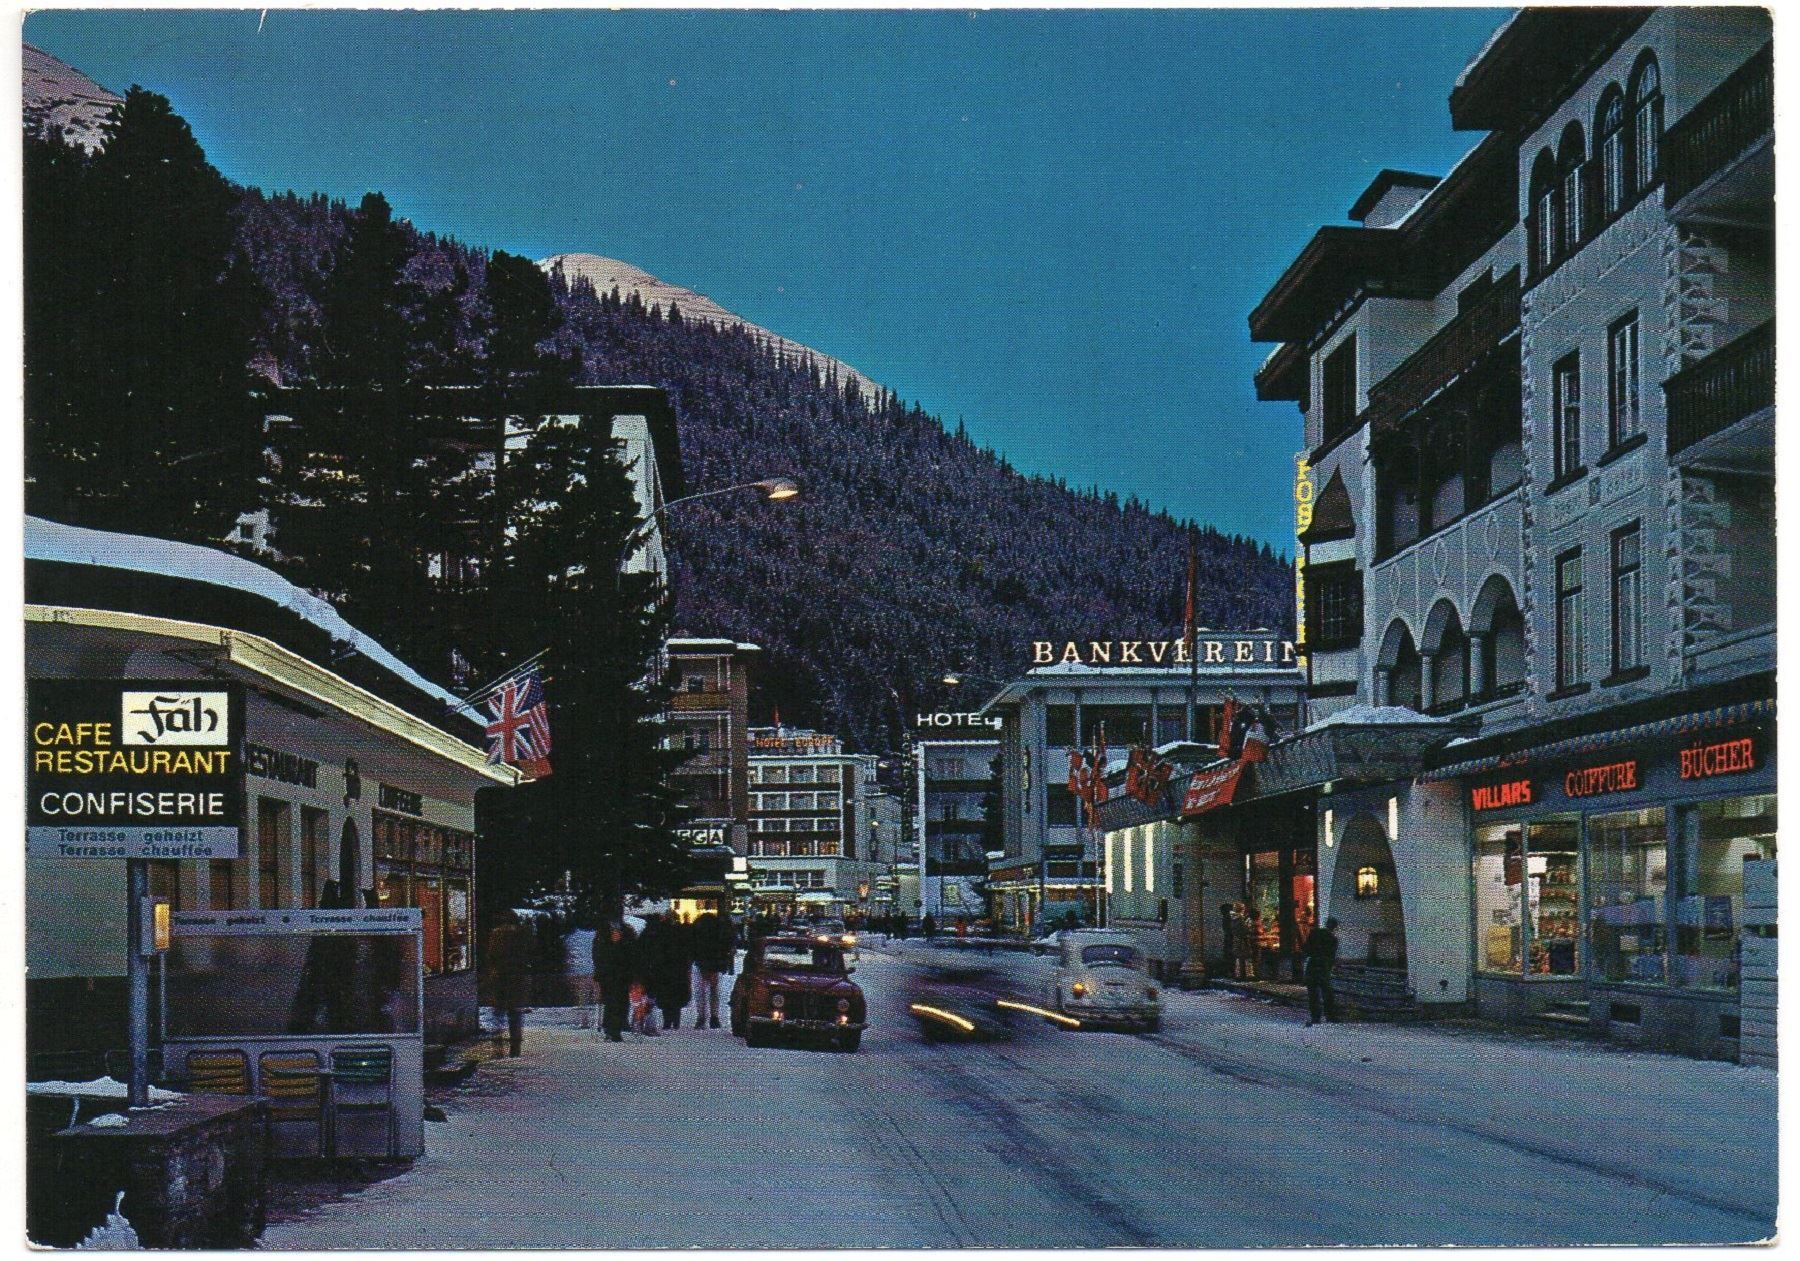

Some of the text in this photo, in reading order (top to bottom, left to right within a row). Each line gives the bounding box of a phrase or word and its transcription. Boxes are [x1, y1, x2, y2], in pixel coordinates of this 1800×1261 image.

[34, 722, 112, 746] CAFE
[34, 751, 231, 774] RESTAURANT
[1680, 738, 1755, 780] BÜCHER
[1564, 760, 1637, 797] COIFFURE
[40, 792, 224, 816] CONFISERIE
[1472, 780, 1531, 810] VILLARS
[58, 829, 205, 844] Terrasse geheizt
[58, 844, 127, 856] Terrasse
